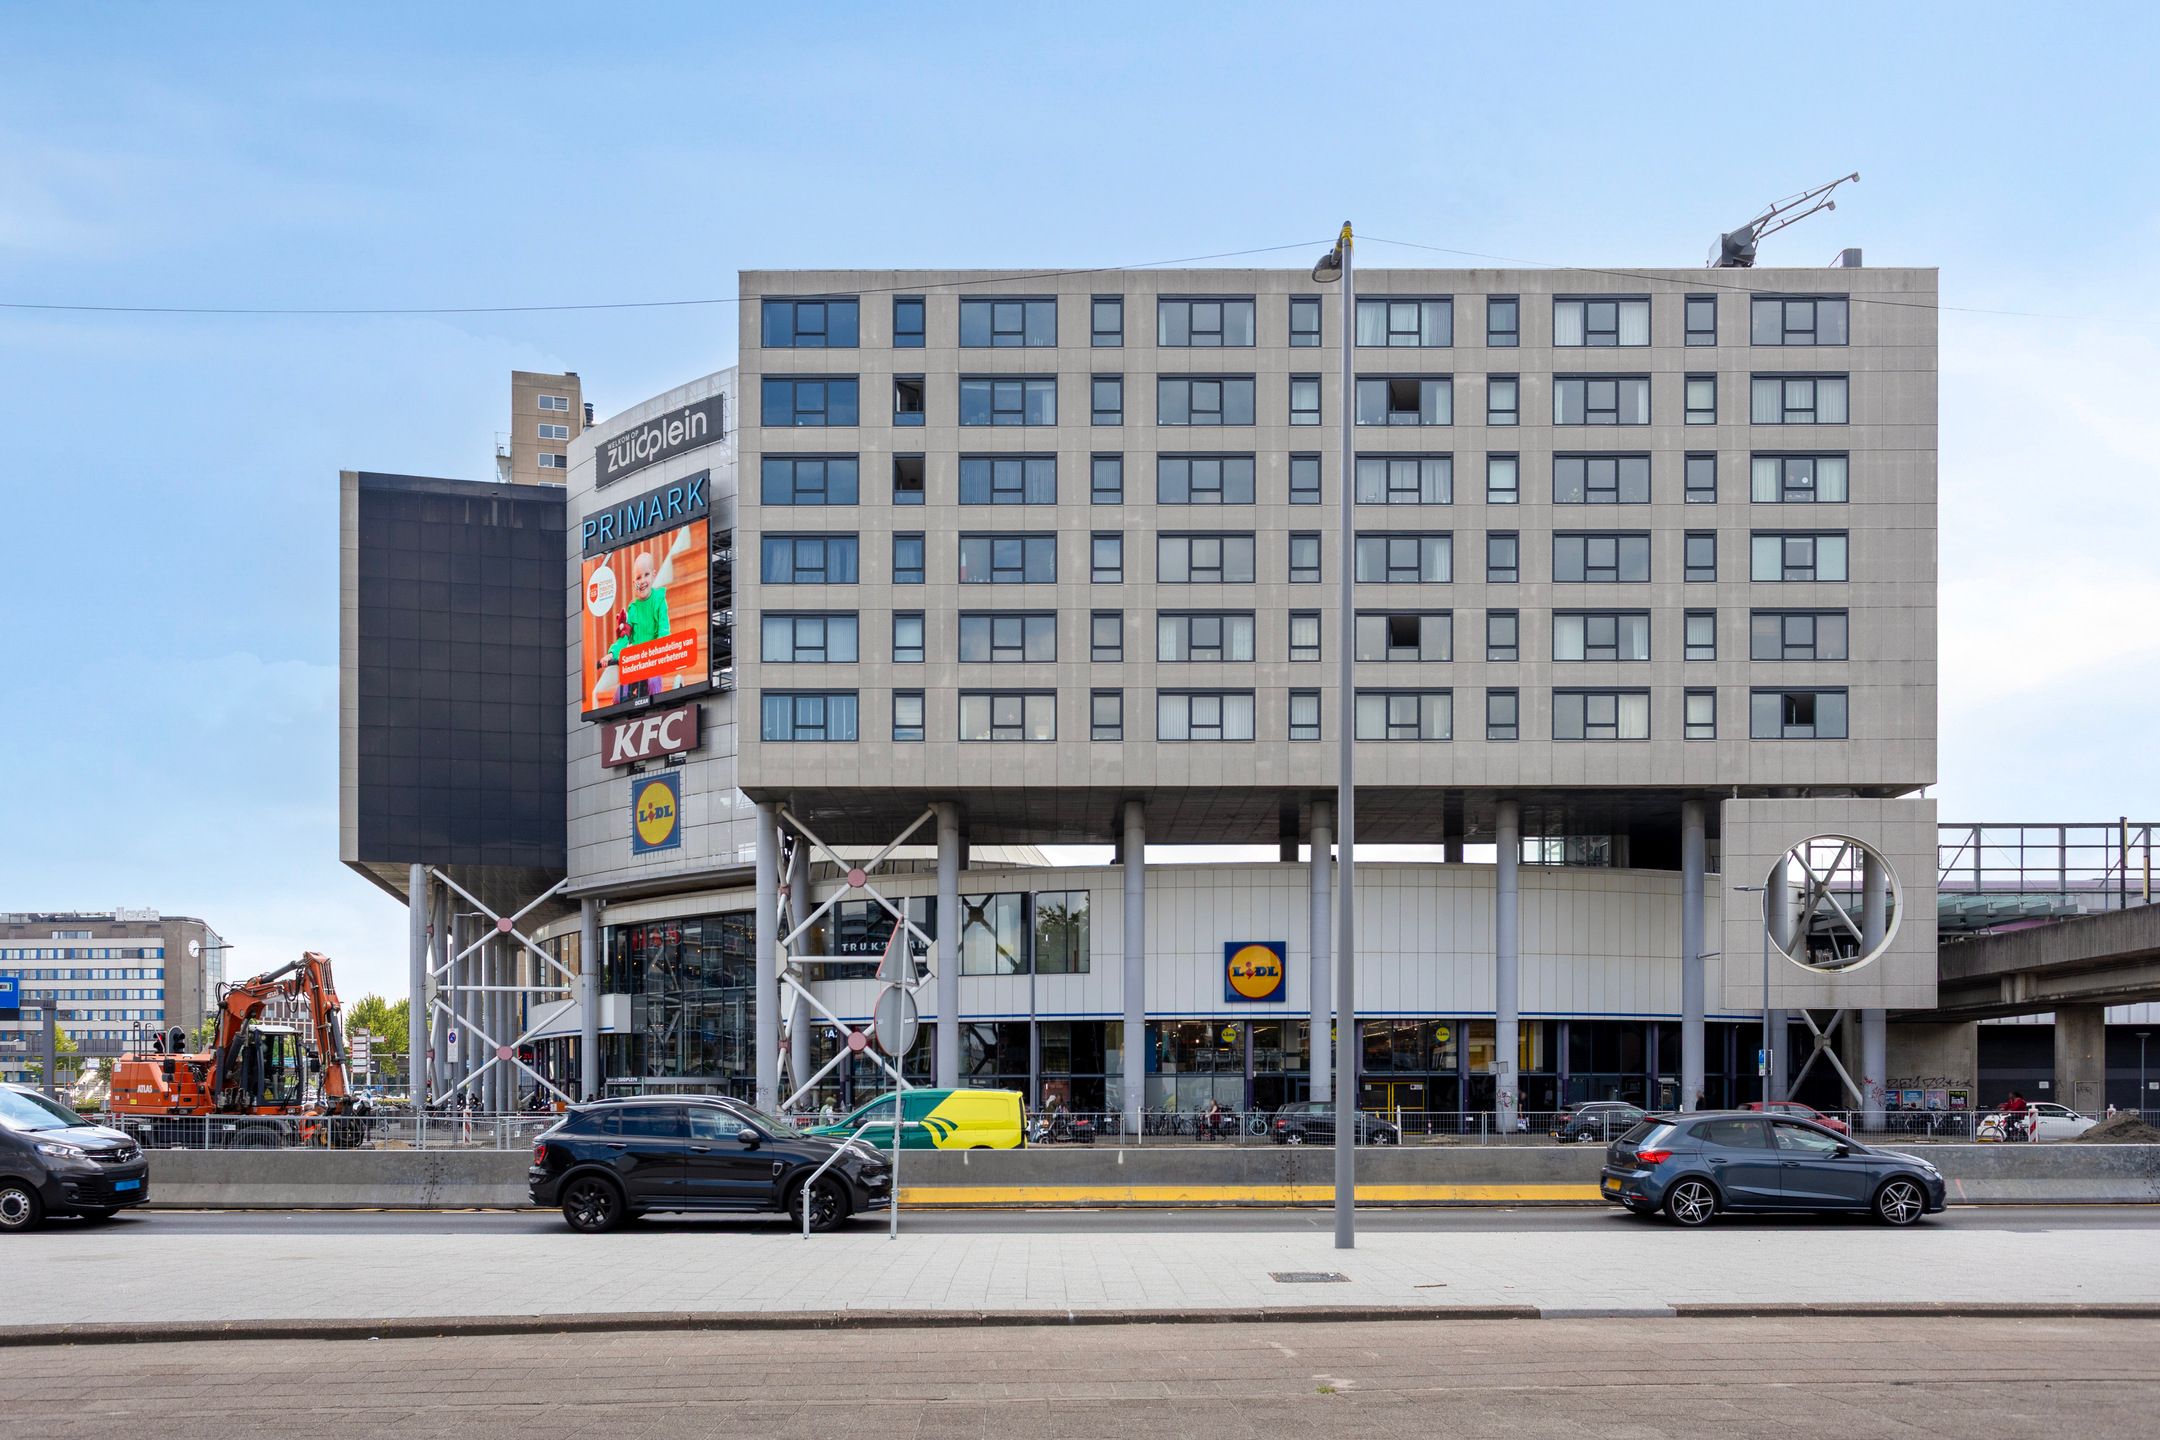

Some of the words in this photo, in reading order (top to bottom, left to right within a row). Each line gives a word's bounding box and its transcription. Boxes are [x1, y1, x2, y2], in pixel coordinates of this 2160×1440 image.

[607, 433, 630, 450] WELKOM
[630, 430, 639, 440] OP
[583, 477, 706, 549] PRIMARK
[621, 653, 641, 664] Samen
[640, 650, 648, 659] de
[648, 641, 682, 656] behandeling
[682, 637, 693, 647] van
[622, 658, 658, 674] kinderkanker
[657, 650, 688, 664] verbeteren
[609, 710, 686, 762] KFC
[136, 1084, 153, 1094] ATLAS
